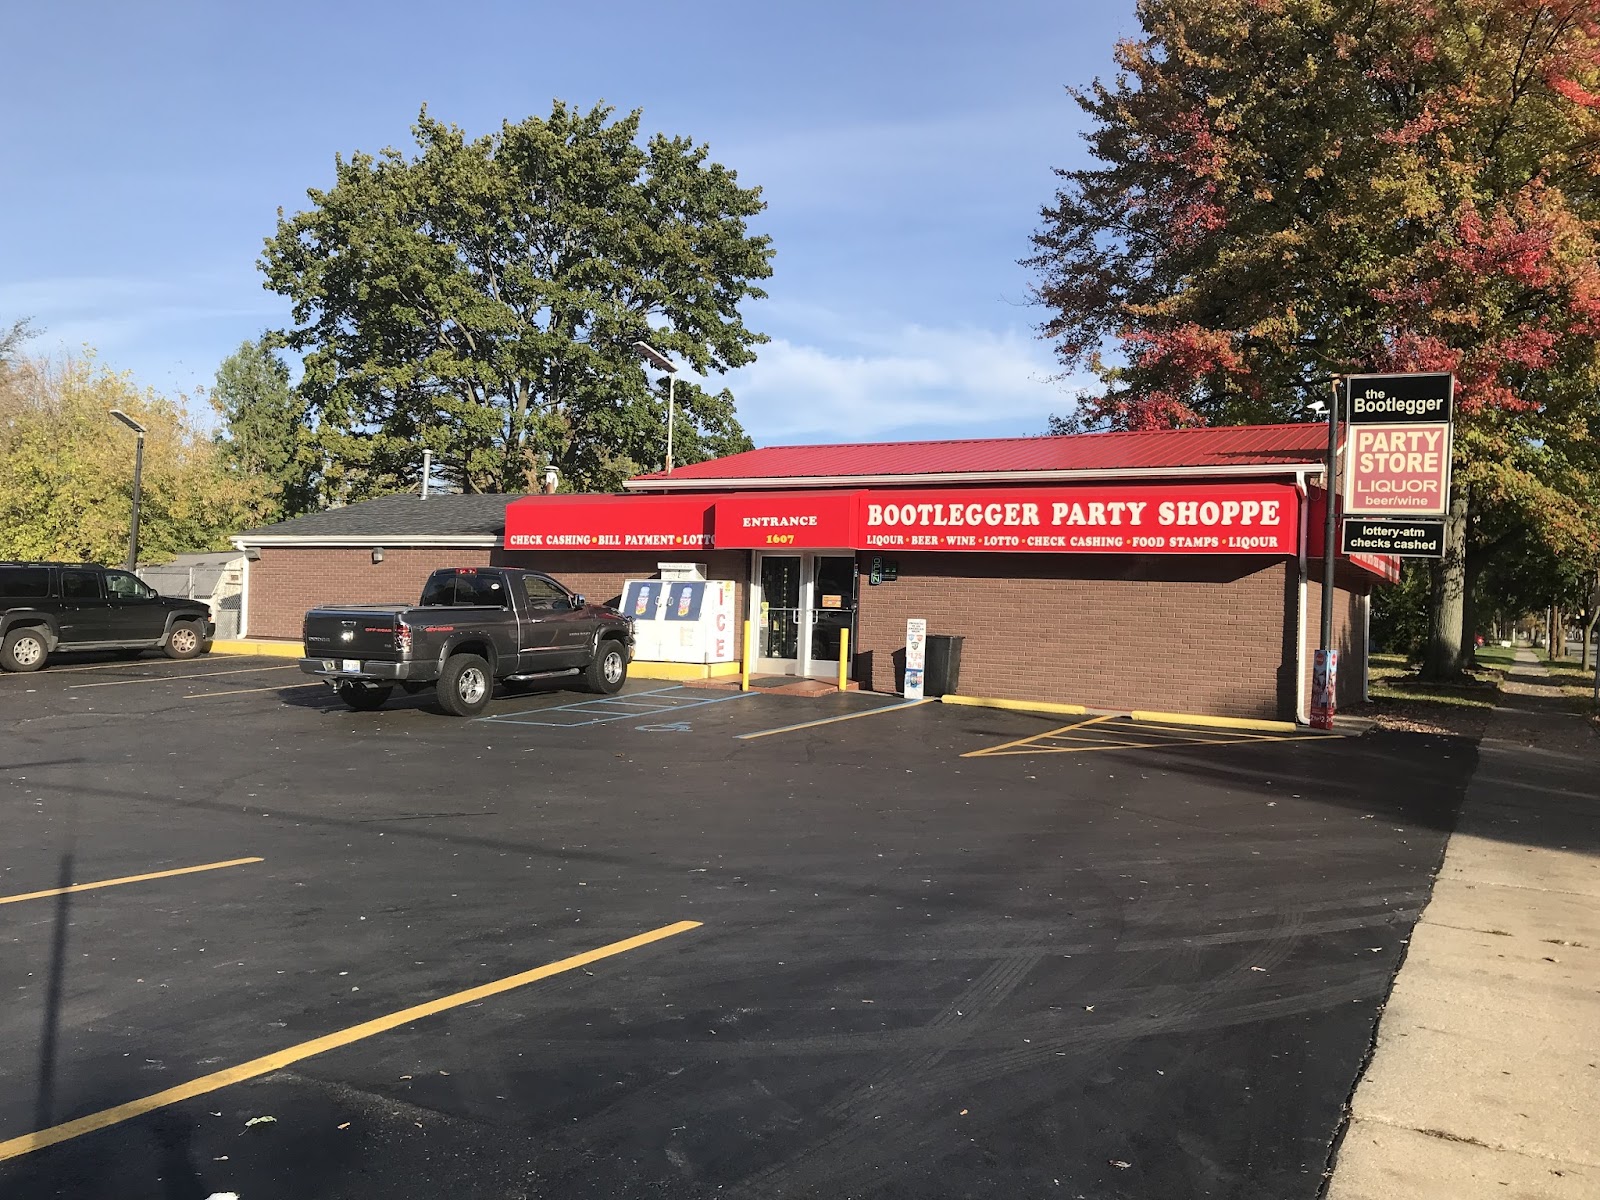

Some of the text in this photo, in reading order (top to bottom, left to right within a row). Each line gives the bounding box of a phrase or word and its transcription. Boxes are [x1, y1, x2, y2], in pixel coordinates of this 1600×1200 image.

[1365, 389, 1385, 399] the
[1354, 397, 1443, 415] Bootlegger
[1359, 431, 1441, 452] PARTY
[1360, 452, 1438, 473] STORE
[1357, 480, 1437, 492] LIQUOR
[1365, 496, 1428, 505] beer/wine
[867, 501, 1280, 526] BOOTLEGGER PARTY SHOPPE
[742, 516, 817, 527] ENTRANCE
[1363, 526, 1425, 538] lottery-atm
[510, 535, 543, 545] CHECK
[546, 535, 591, 545] CASHING
[598, 535, 621, 545] BILL
[625, 535, 675, 545] PAYMENT
[766, 534, 794, 544] 1607
[867, 535, 1278, 549] LIQOUR BEER WINE LOTTO CHECK CASHING FOOD STAMPS LIQOUR
[1350, 538, 1436, 550] checks cashed
[716, 588, 725, 657] ICE
